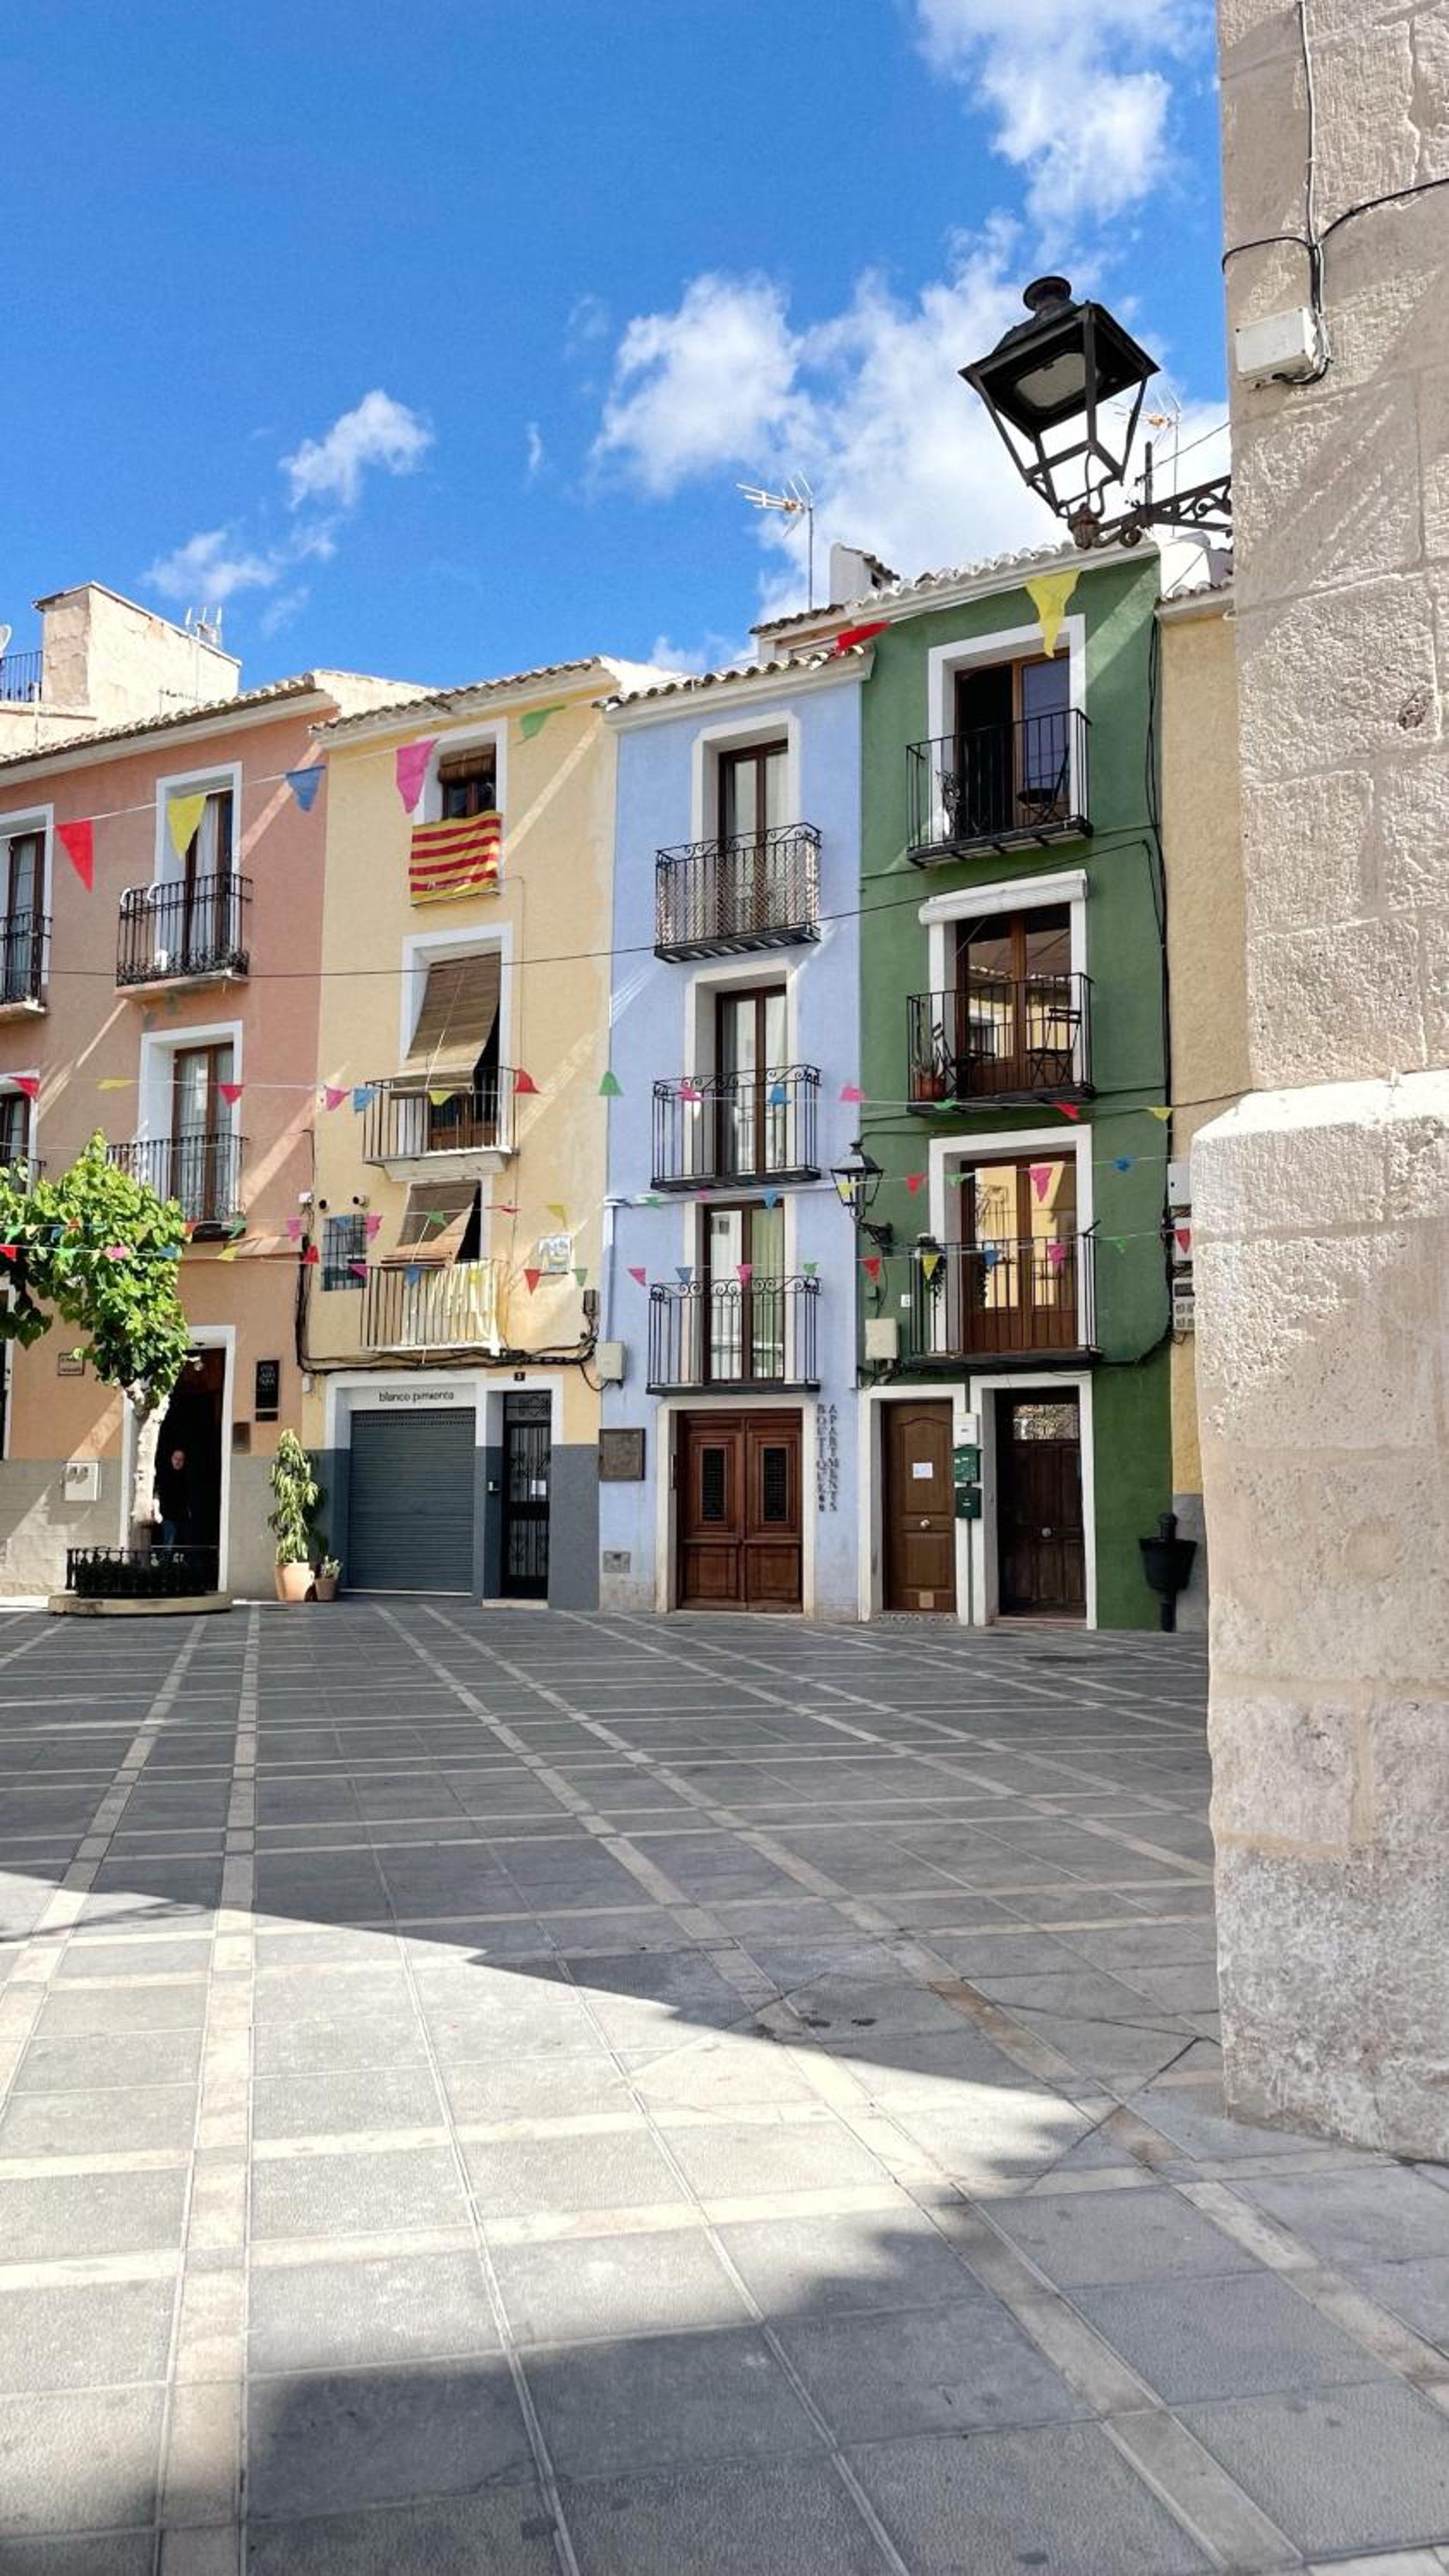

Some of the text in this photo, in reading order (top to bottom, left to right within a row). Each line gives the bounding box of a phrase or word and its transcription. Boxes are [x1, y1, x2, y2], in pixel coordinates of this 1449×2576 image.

[379, 1391, 454, 1404] blanco pimienta
[828, 1403, 839, 1512] APARTMENTS
